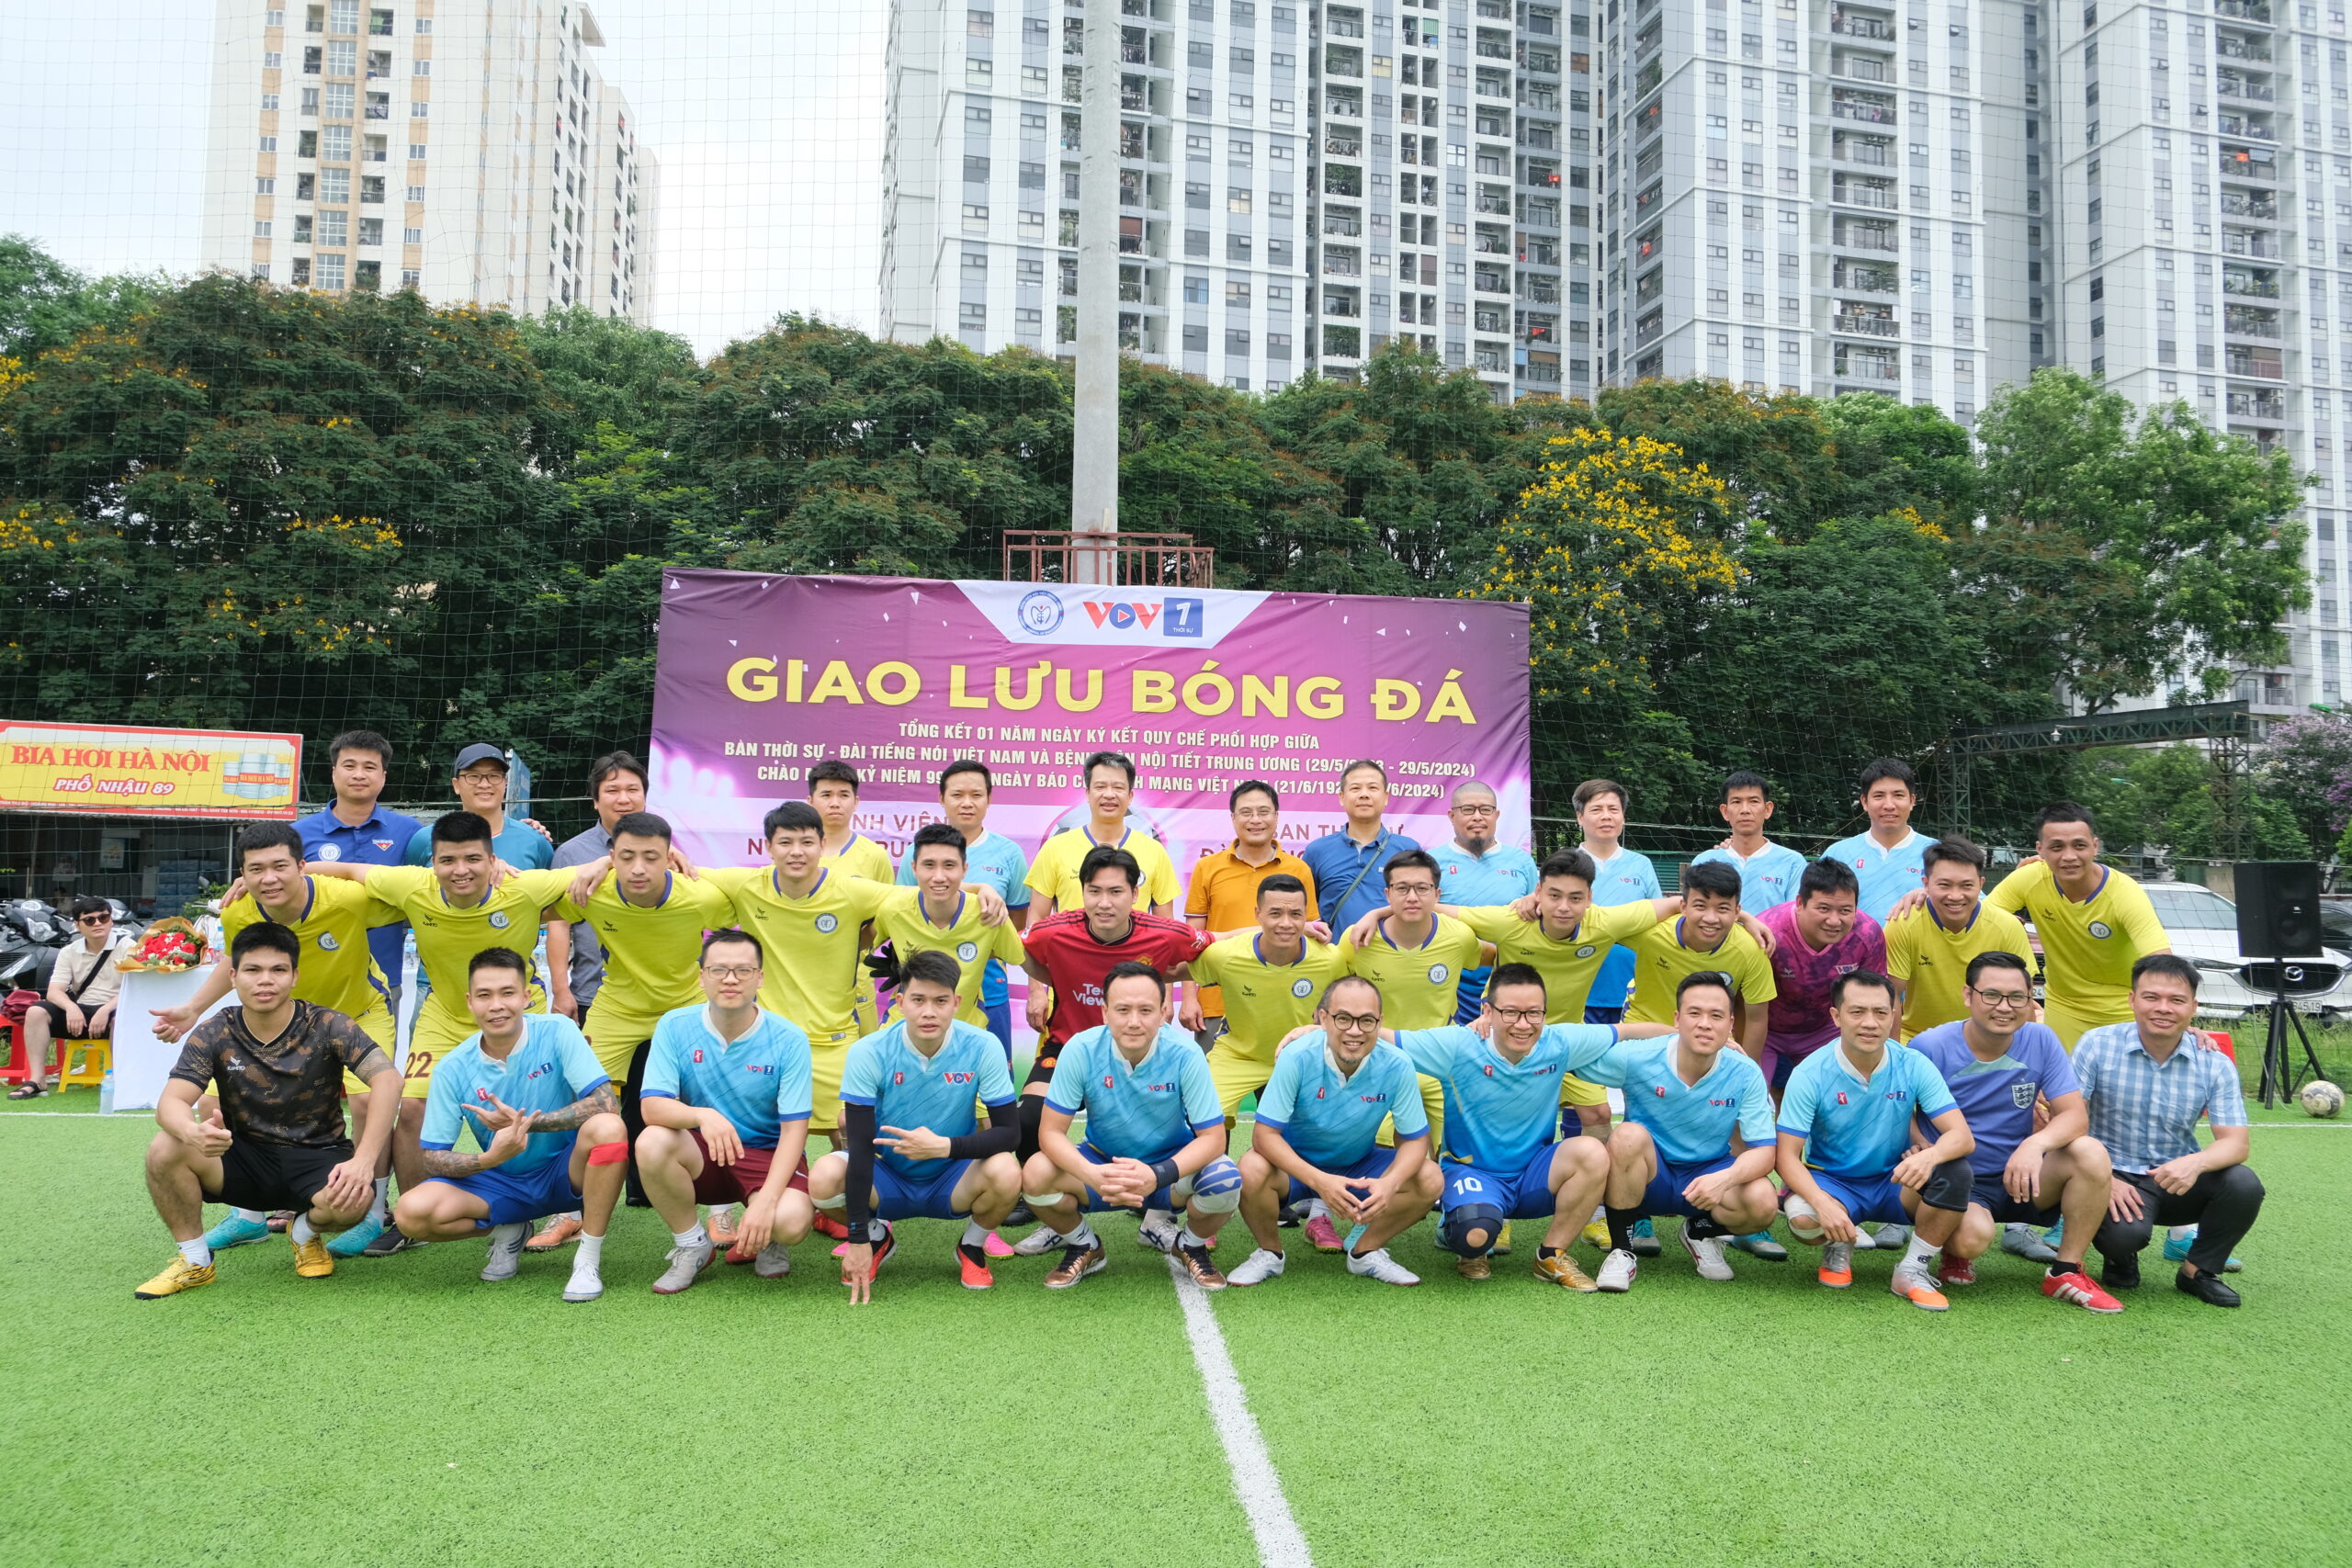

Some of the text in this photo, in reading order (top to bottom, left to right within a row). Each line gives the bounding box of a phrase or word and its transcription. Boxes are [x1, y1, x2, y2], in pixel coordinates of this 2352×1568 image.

[1082, 602, 1162, 630] VOV
[1176, 602, 1192, 626] 1
[727, 657, 1477, 724] GIAO LƯU BÓNG ĐÁ
[899, 718, 1320, 750] TỔNG KẾT 01 NĂM NGÀY KÝ KẾT QUY CHẾ PHỐI HỢP GIỮA
[11, 745, 57, 765] BIA
[119, 747, 157, 770] HÀ
[162, 750, 210, 776] NỘI
[763, 740, 797, 758] THỜI
[803, 743, 825, 761] SỰ
[840, 742, 865, 759] ĐÀI
[871, 742, 916, 760] TIẾNG
[921, 745, 947, 761] NÓI
[989, 750, 1025, 764] NAM
[1030, 748, 1050, 764] VÀ
[1141, 751, 1166, 769] NỘI
[1171, 750, 1201, 769] TIẾT
[1206, 755, 1254, 771] TRUNG
[1260, 756, 1300, 772] ƯƠNG
[1398, 761, 1476, 778] 29/5/2024)
[54, 773, 175, 796] PHỐ NHẬU 89
[757, 764, 799, 781] CHÀO
[881, 767, 922, 785] NIỆM
[991, 772, 1032, 787] NGÀY
[1036, 772, 1068, 788] BÁO
[1148, 776, 1193, 793] MẠNG
[1197, 776, 1229, 795] VIỆT
[1274, 780, 1341, 795] (21/6/192
[404, 1051, 433, 1078] 22
[943, 1072, 975, 1085] VOV
[1453, 1177, 1483, 1196] 10
